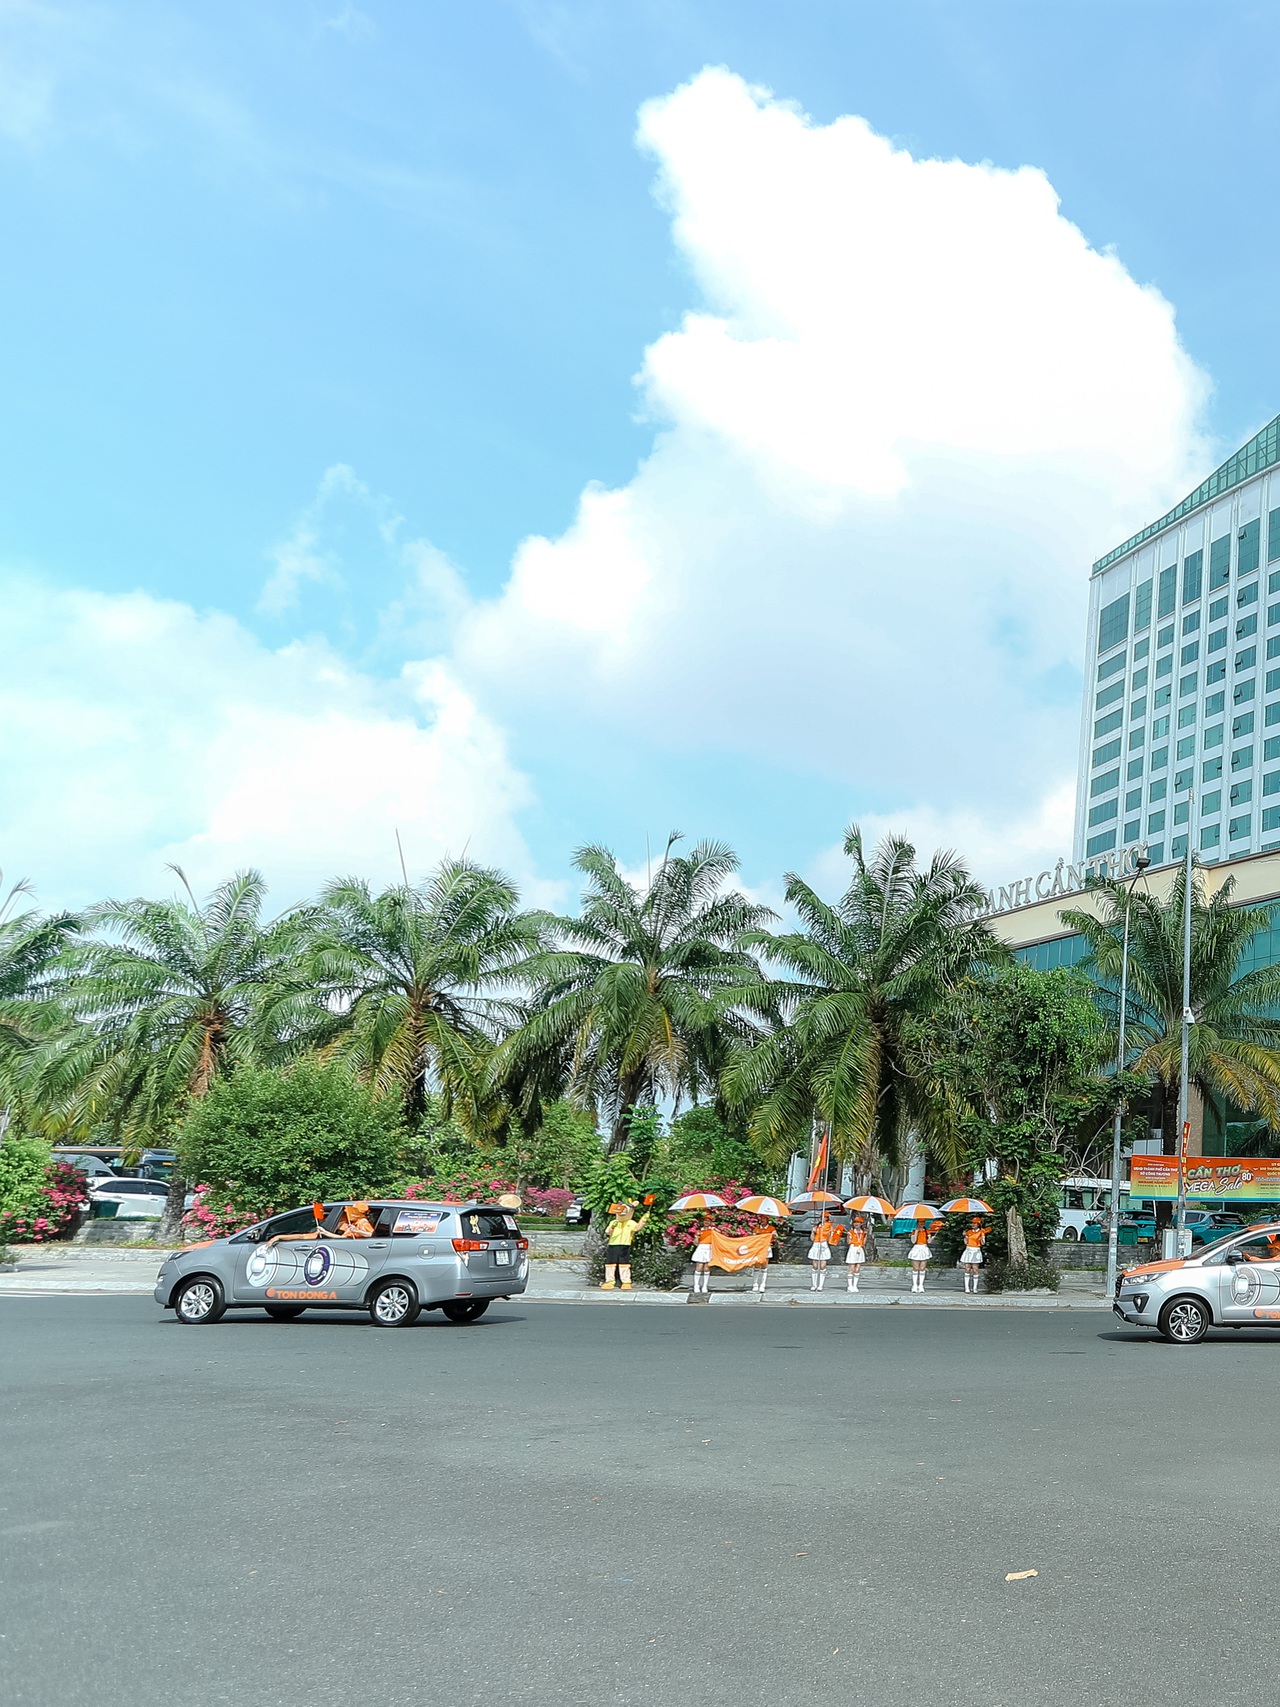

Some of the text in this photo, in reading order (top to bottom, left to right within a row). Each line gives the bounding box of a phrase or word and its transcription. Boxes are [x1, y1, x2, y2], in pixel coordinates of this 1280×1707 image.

[970, 840, 1148, 919] ANH CẦN THƠ
[1188, 1163, 1242, 1180] CẦN THƠ
[1185, 1177, 1243, 1195] MEGA Sale
[276, 1291, 337, 1299] TON DONG A
